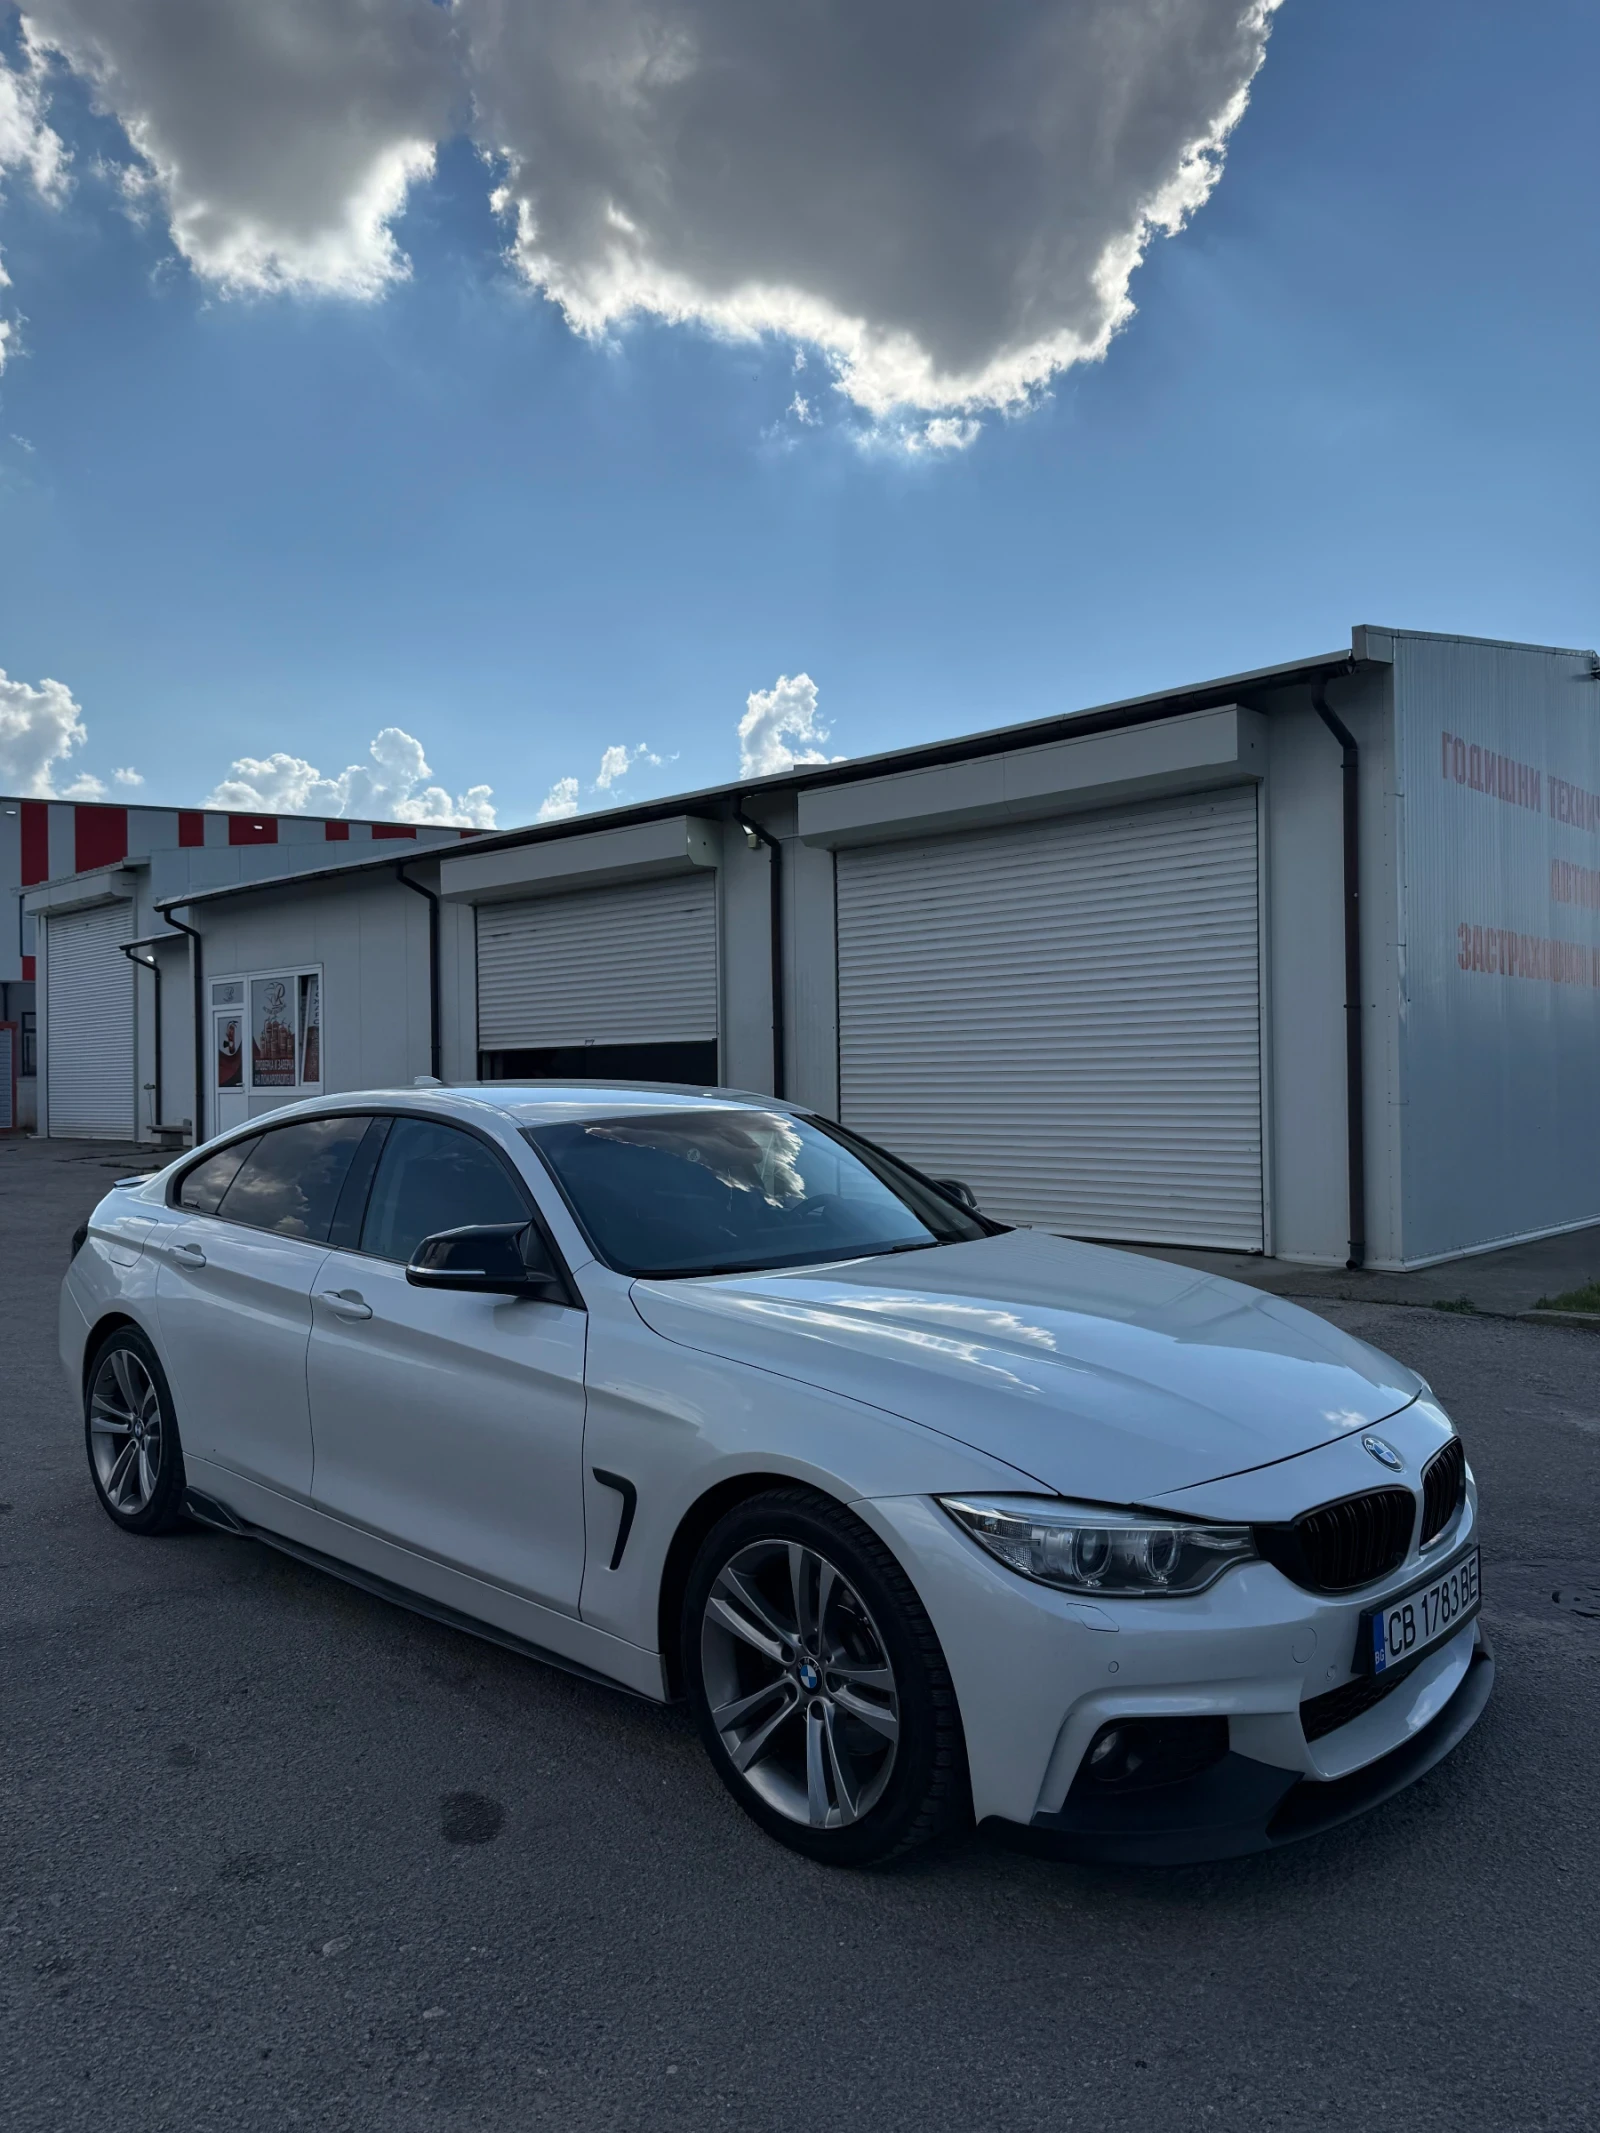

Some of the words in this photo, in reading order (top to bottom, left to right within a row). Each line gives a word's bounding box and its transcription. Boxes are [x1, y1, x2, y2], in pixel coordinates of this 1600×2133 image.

[1441, 730, 1541, 813] ГОДИШНИ
[1388, 1602, 1416, 1657] CB
[1421, 1574, 1459, 1637] 1783
[1460, 1556, 1478, 1608] BE
[1374, 1648, 1385, 1664] BG
